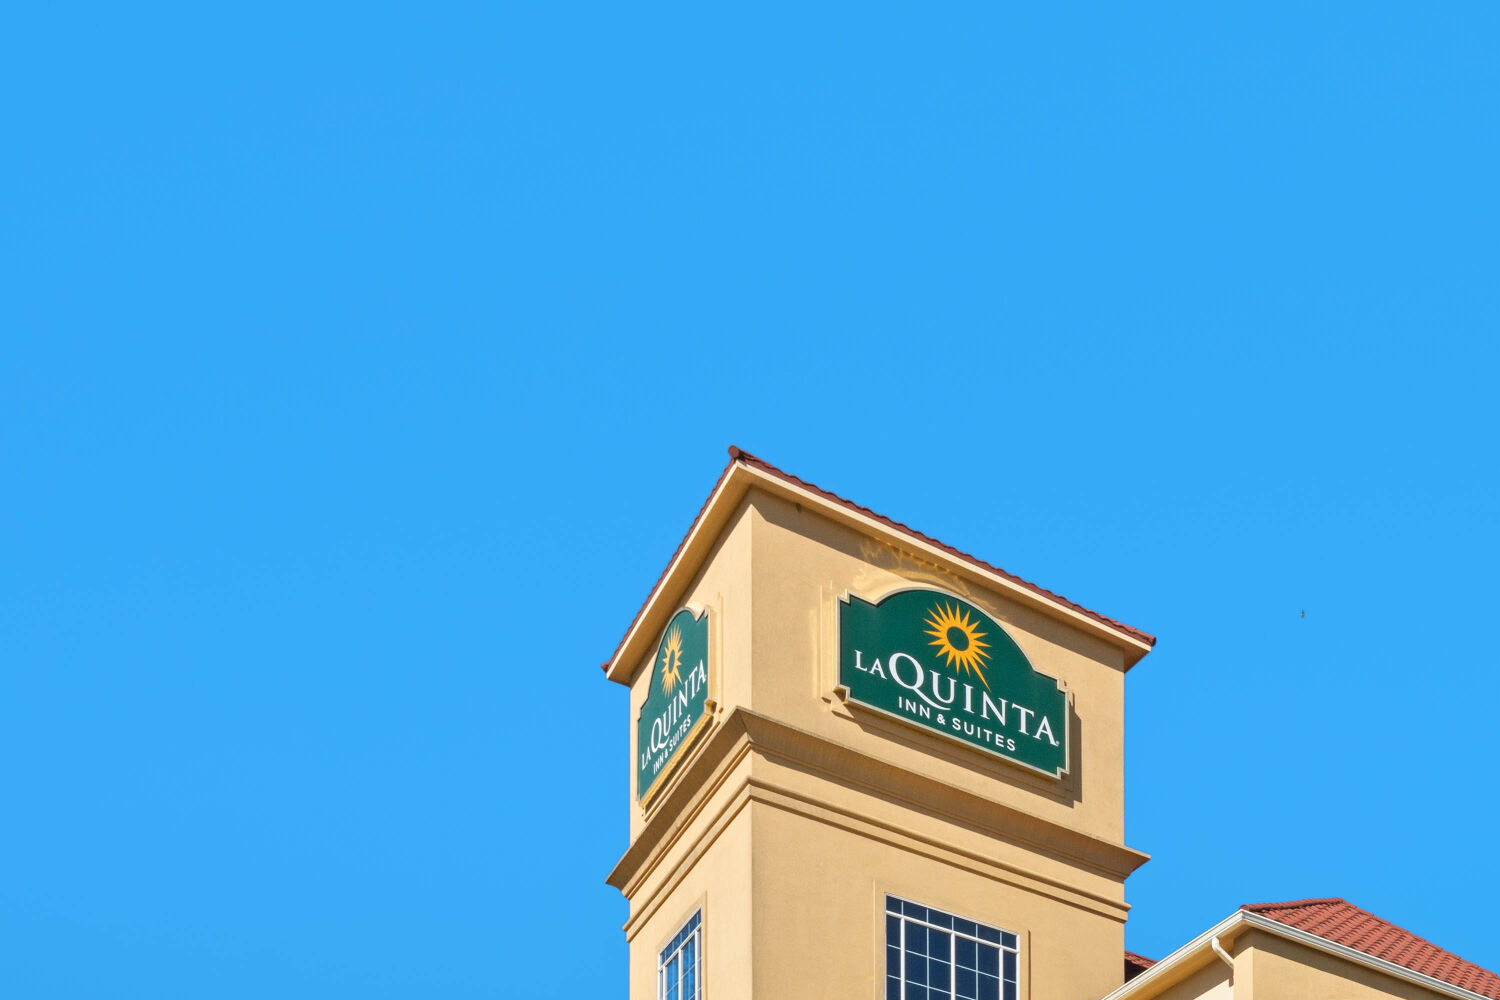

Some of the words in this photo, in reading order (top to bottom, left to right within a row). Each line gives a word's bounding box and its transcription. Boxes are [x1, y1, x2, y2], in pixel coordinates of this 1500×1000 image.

[653, 757, 664, 775] INN
[669, 714, 692, 751] SUITES
[898, 696, 931, 720] INN
[937, 713, 946, 726] &
[952, 717, 1016, 751] SUITES
